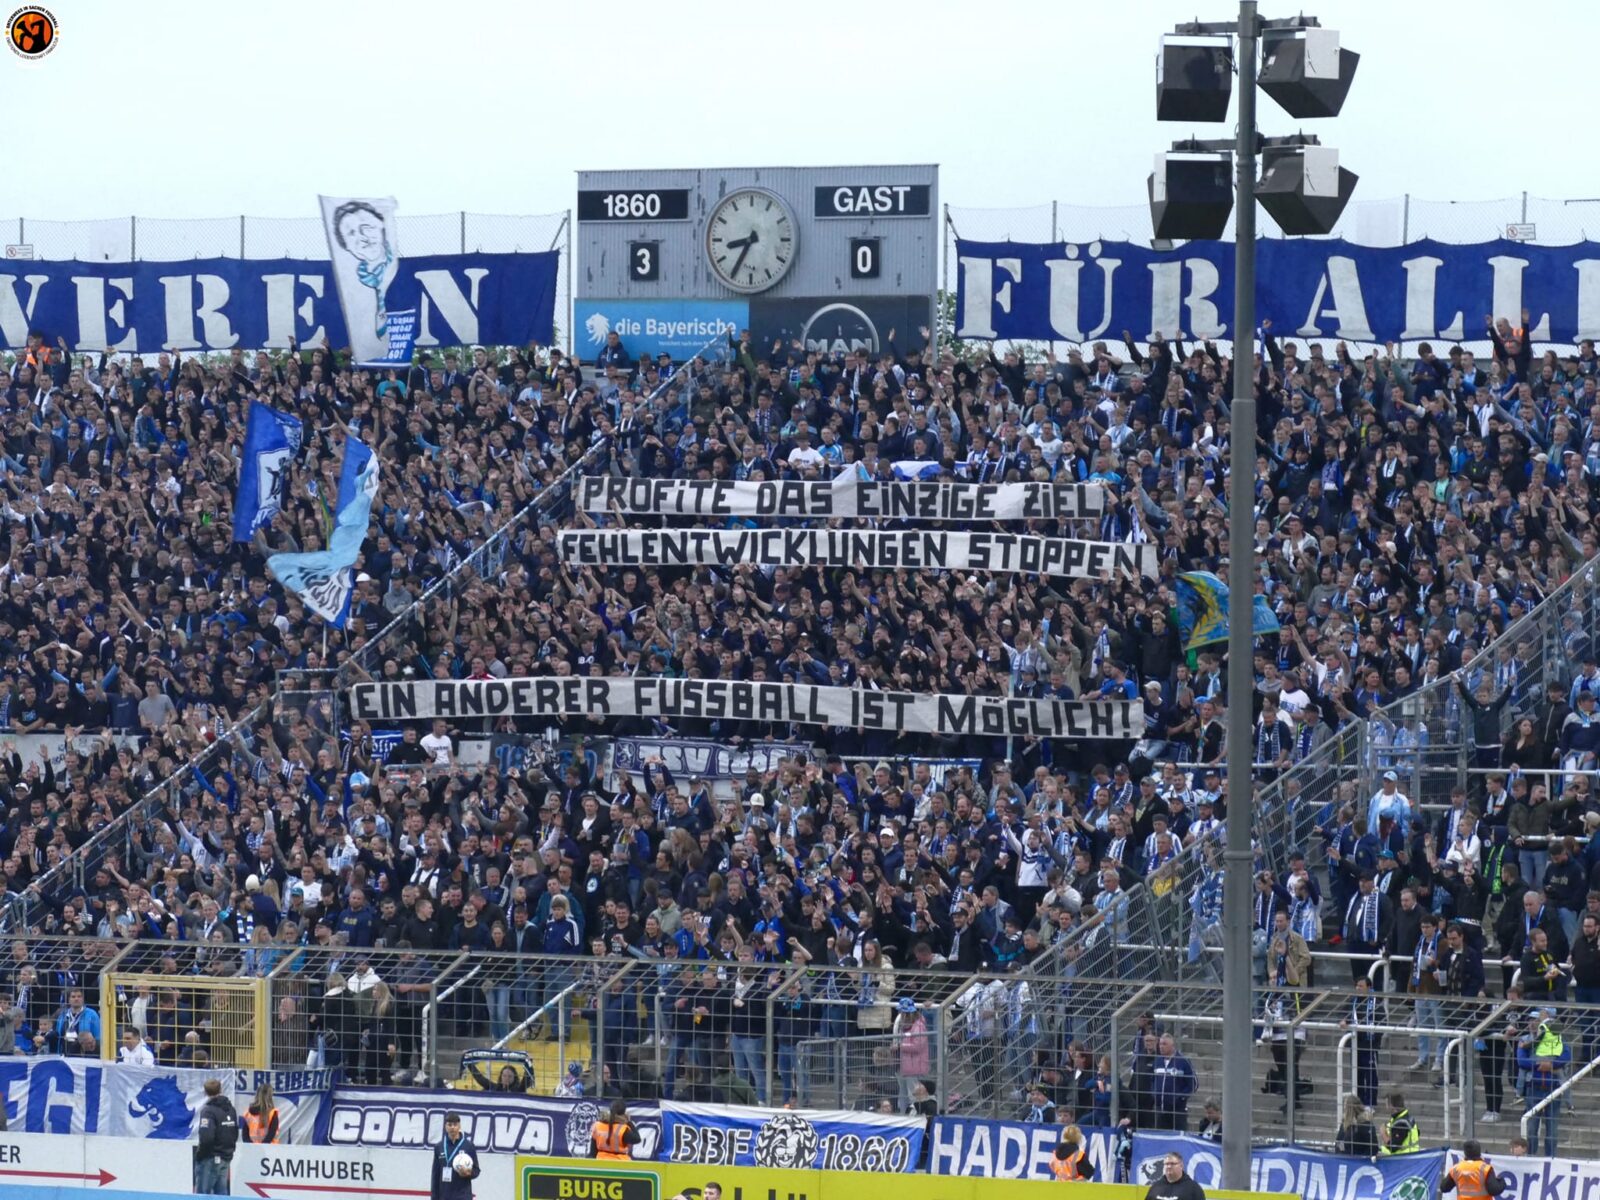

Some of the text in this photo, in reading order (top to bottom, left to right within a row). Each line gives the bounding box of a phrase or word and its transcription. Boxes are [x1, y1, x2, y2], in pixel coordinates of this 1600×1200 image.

[603, 193, 661, 218] 1860
[833, 186, 911, 213] GAST
[636, 248, 651, 275] 3
[857, 246, 872, 273] 0
[957, 240, 1227, 343] FÜR
[0, 268, 489, 352] VEREN
[614, 318, 736, 338] die Bayerische
[806, 338, 873, 353] MAN
[756, 482, 833, 515] DAS
[562, 530, 1143, 581] FEHLENTWICKLUNGEN STOPPEN
[355, 684, 418, 719] EIN
[434, 683, 610, 716] ANDERER
[634, 680, 829, 723] FUSSBALL
[851, 690, 915, 730] IST
[638, 745, 711, 773] TSV
[671, 1123, 909, 1173] BBF 1860
[260, 1157, 374, 1181] SAMHUBER
[558, 1179, 623, 1199] BURG
